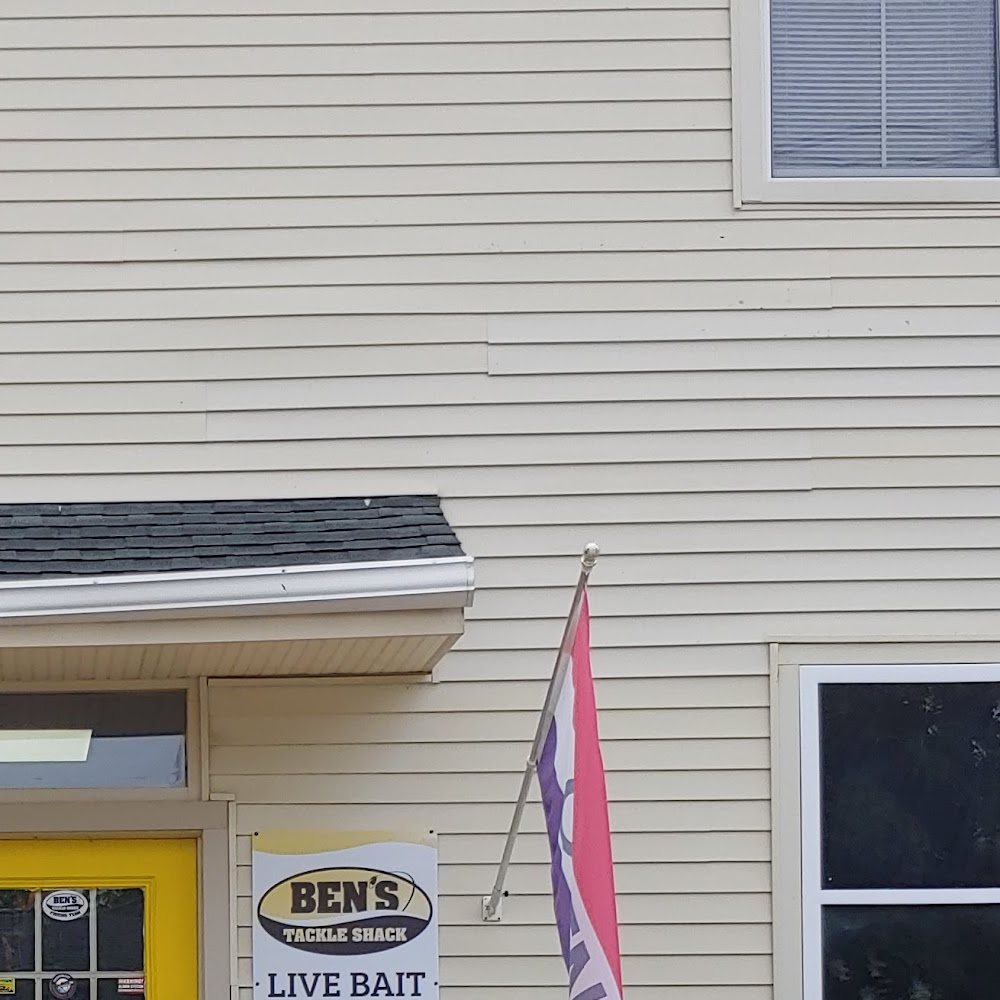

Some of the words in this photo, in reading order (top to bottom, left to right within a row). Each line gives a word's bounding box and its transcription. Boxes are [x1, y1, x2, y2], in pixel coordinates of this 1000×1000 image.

[53, 895, 77, 904] BEN'S
[290, 875, 400, 914] BEN'S
[283, 927, 348, 943] TACKLE
[352, 926, 408, 942] SHACK
[267, 973, 341, 997] LIVE
[350, 972, 426, 997] BAIT
